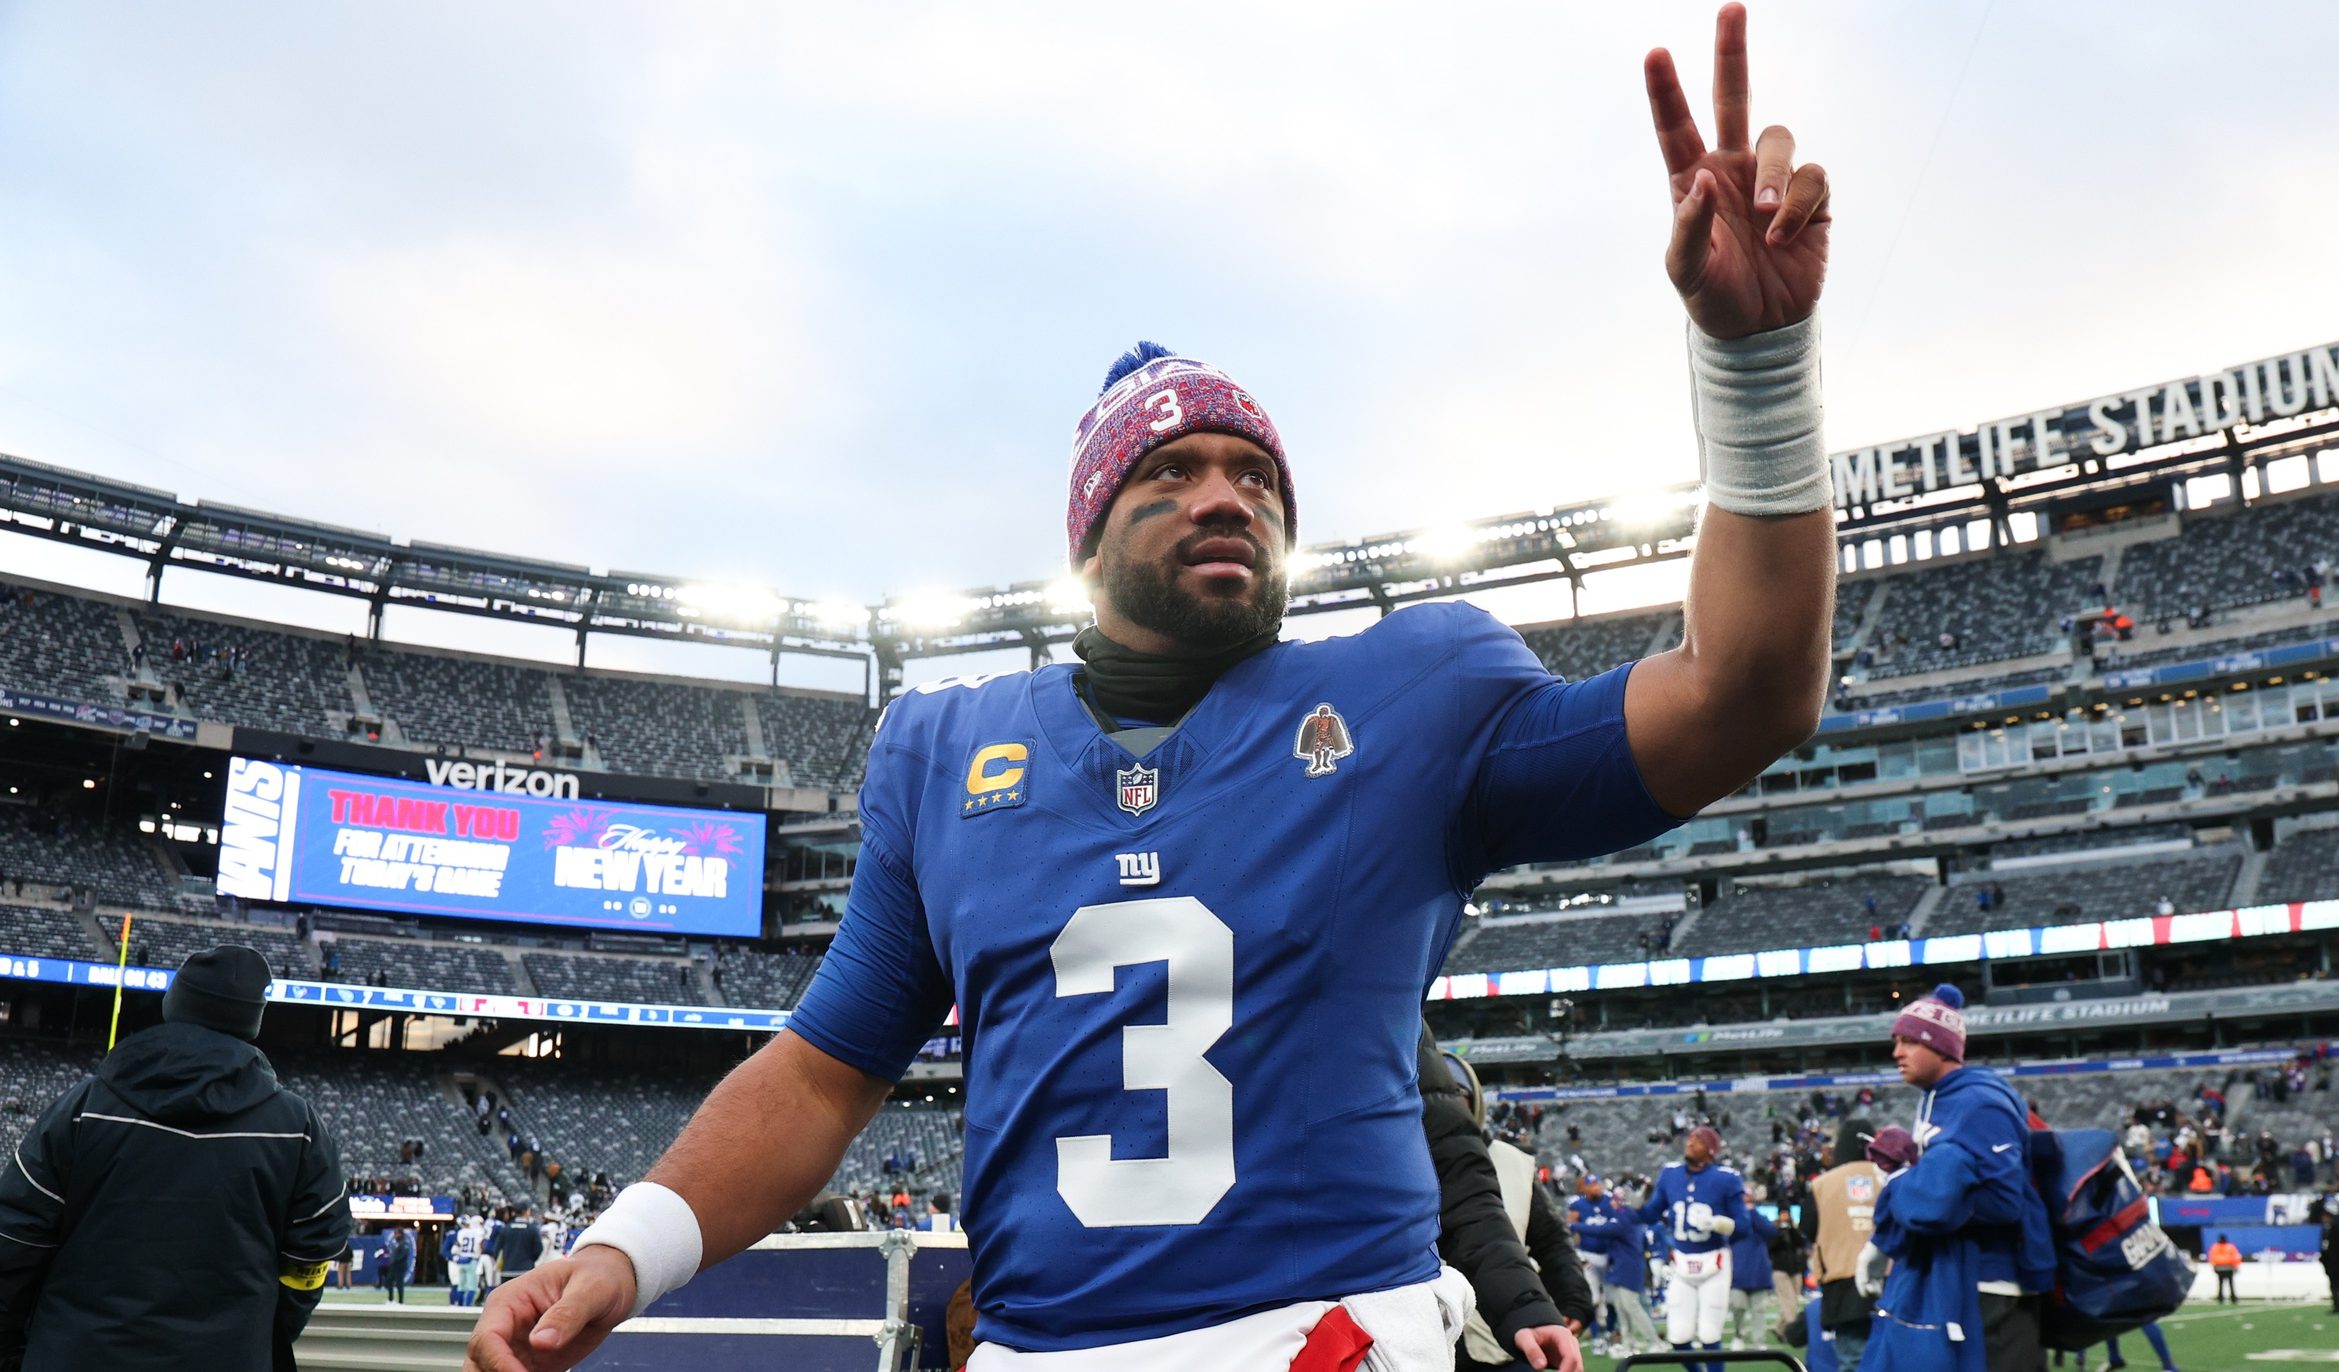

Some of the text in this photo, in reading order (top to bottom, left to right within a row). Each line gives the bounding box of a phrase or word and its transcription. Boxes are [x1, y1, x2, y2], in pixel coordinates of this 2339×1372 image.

[1144, 388, 1184, 431] 3
[1832, 407, 2071, 506] METLIFE
[425, 759, 580, 800] verizon
[967, 743, 1028, 795] C
[328, 788, 520, 841] THANK YOU
[1124, 787, 1151, 807] NFL
[216, 757, 284, 900] IANTS
[333, 828, 511, 871] FOR ATTENDING
[598, 823, 687, 858] Happy
[339, 857, 503, 898] TODAY'S GAME
[554, 845, 728, 898] NEW YEAR
[1115, 852, 1160, 885] ny
[1964, 1007, 2055, 1026] METLIFE
[2061, 998, 2173, 1021] STADIUM
[1050, 896, 1236, 1228] 3
[461, 1237, 475, 1253] 21
